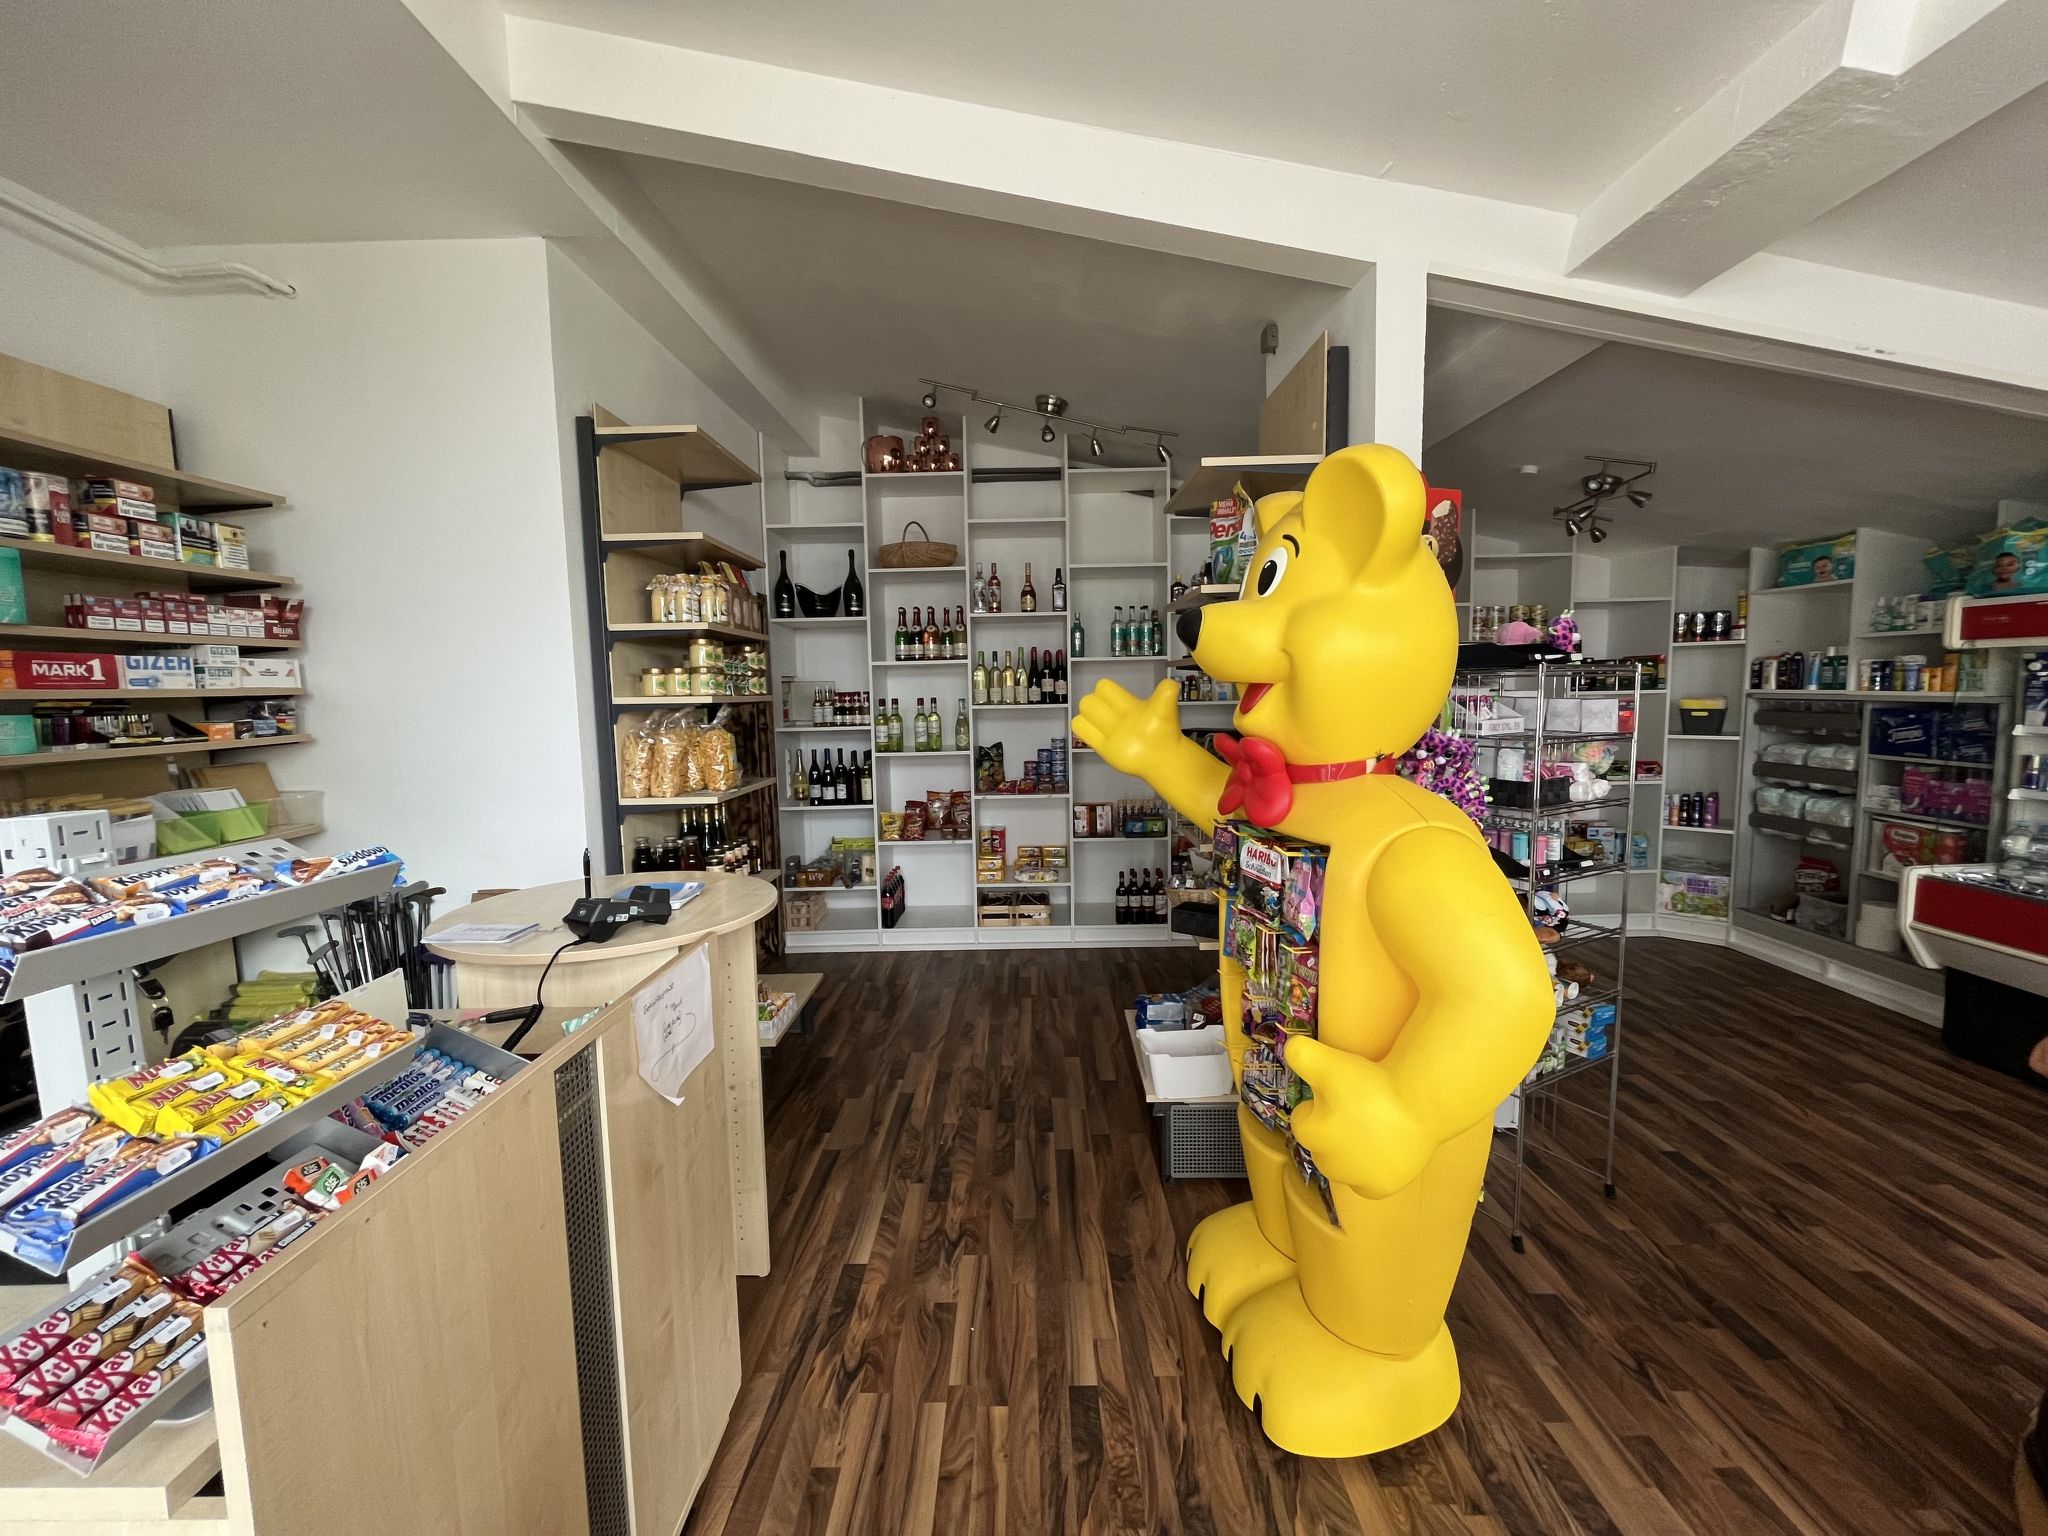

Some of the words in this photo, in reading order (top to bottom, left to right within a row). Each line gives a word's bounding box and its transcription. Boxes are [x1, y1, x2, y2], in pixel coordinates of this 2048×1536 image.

[125, 655, 191, 670] GIZEH
[209, 646, 237, 656] GIZEH
[207, 668, 233, 678] GIZEH
[92, 911, 116, 926] DARK
[379, 1071, 426, 1105] mentos
[394, 1077, 440, 1112] mentos
[408, 1090, 441, 1116] mentos
[194, 1237, 250, 1283] KitKat
[0, 1312, 67, 1377] KitKat
[26, 1332, 100, 1396] KitKat
[57, 1351, 132, 1414] KitKat
[90, 1370, 158, 1434] KitKat
